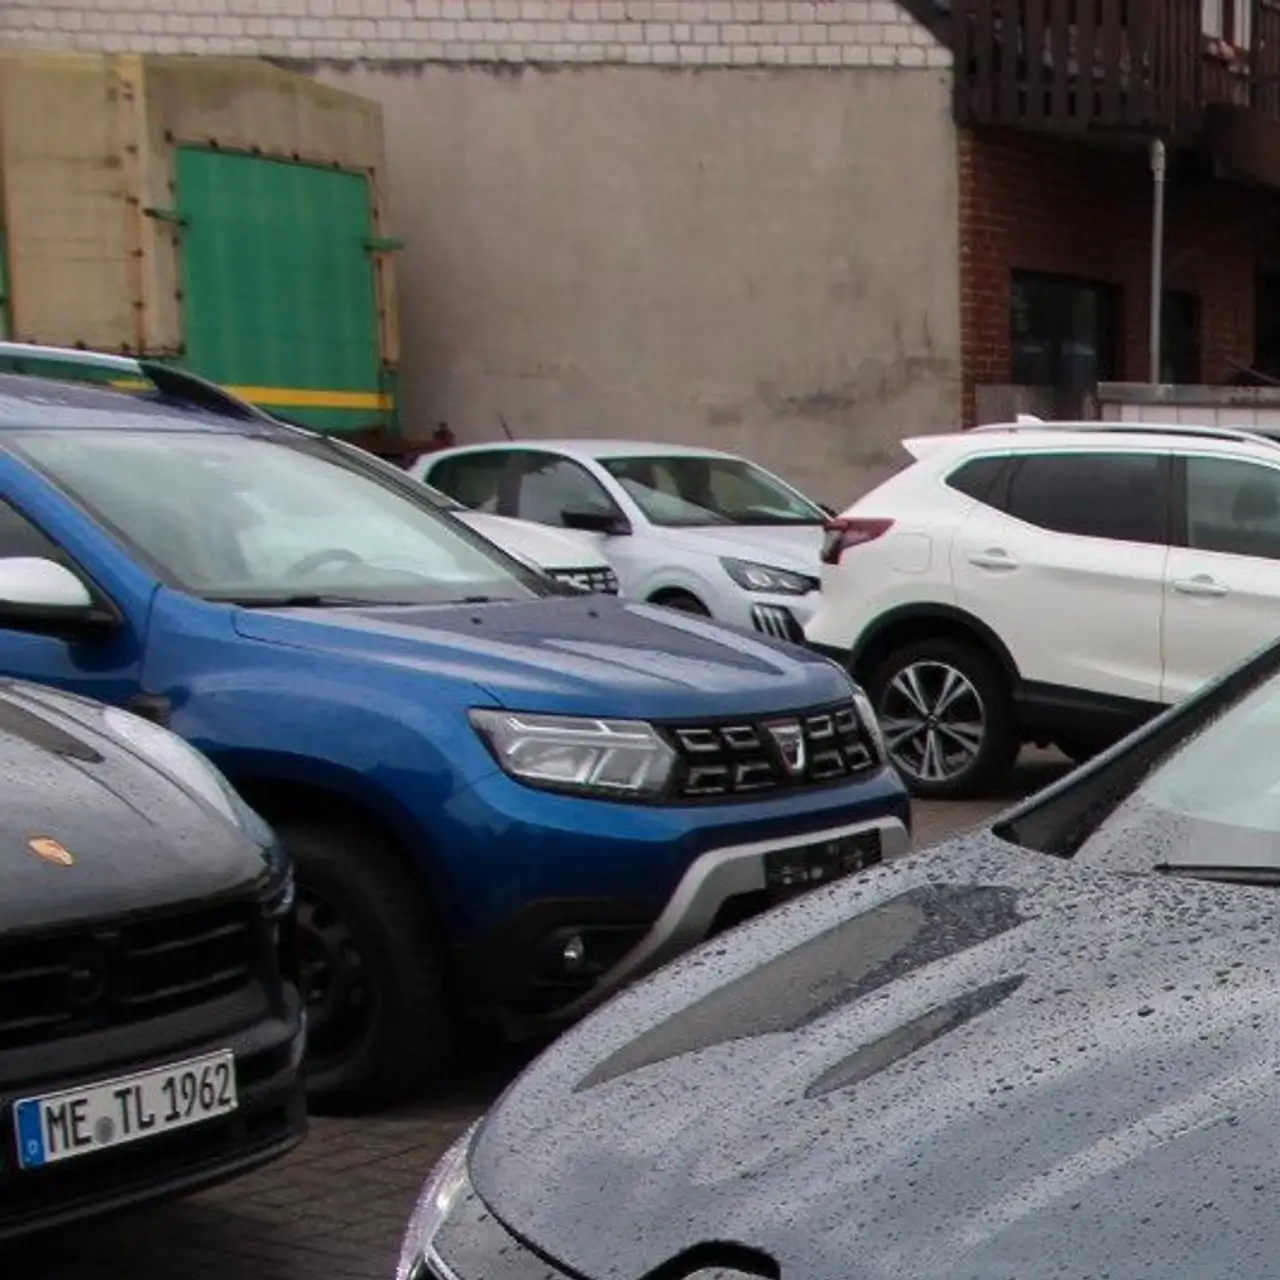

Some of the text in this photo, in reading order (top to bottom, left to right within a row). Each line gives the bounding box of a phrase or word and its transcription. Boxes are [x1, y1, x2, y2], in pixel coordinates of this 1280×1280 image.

[46, 1063, 233, 1153] ME TL 1962
